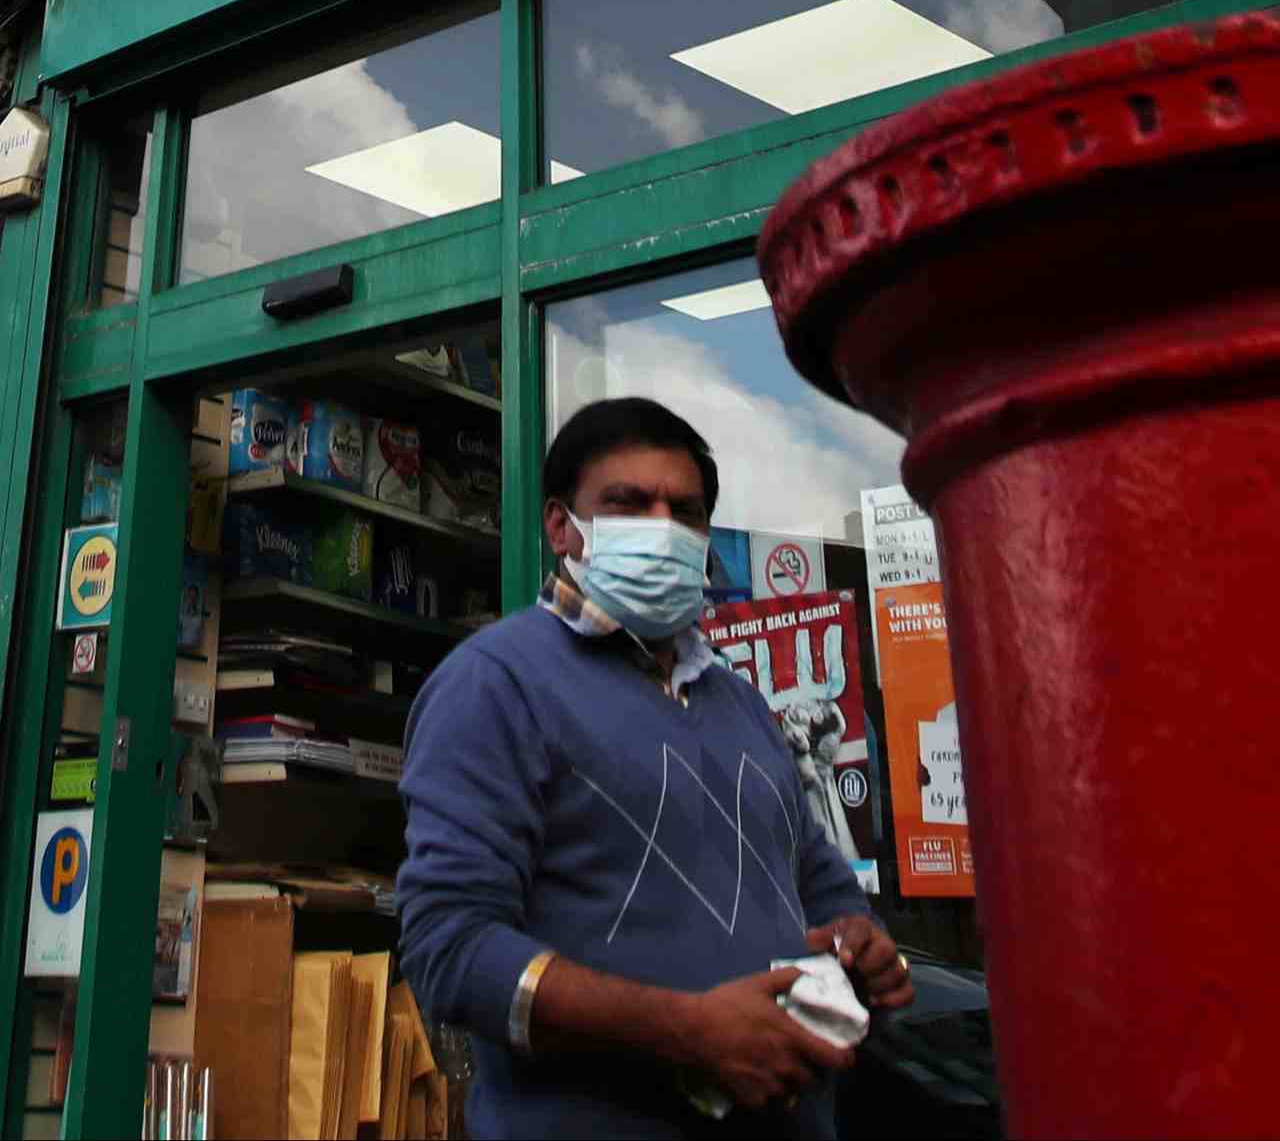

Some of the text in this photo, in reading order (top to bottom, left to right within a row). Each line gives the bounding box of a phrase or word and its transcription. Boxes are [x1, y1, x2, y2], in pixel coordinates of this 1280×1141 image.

[876, 505, 914, 524] POST
[877, 553, 897, 566] TUE
[879, 570, 902, 583] WED
[888, 602, 941, 619] THERE'S
[709, 602, 842, 642] THE FIGHT BACK AGAINST
[888, 618, 922, 634] WITH
[843, 775, 862, 797] FLU
[922, 840, 943, 852] FLU
